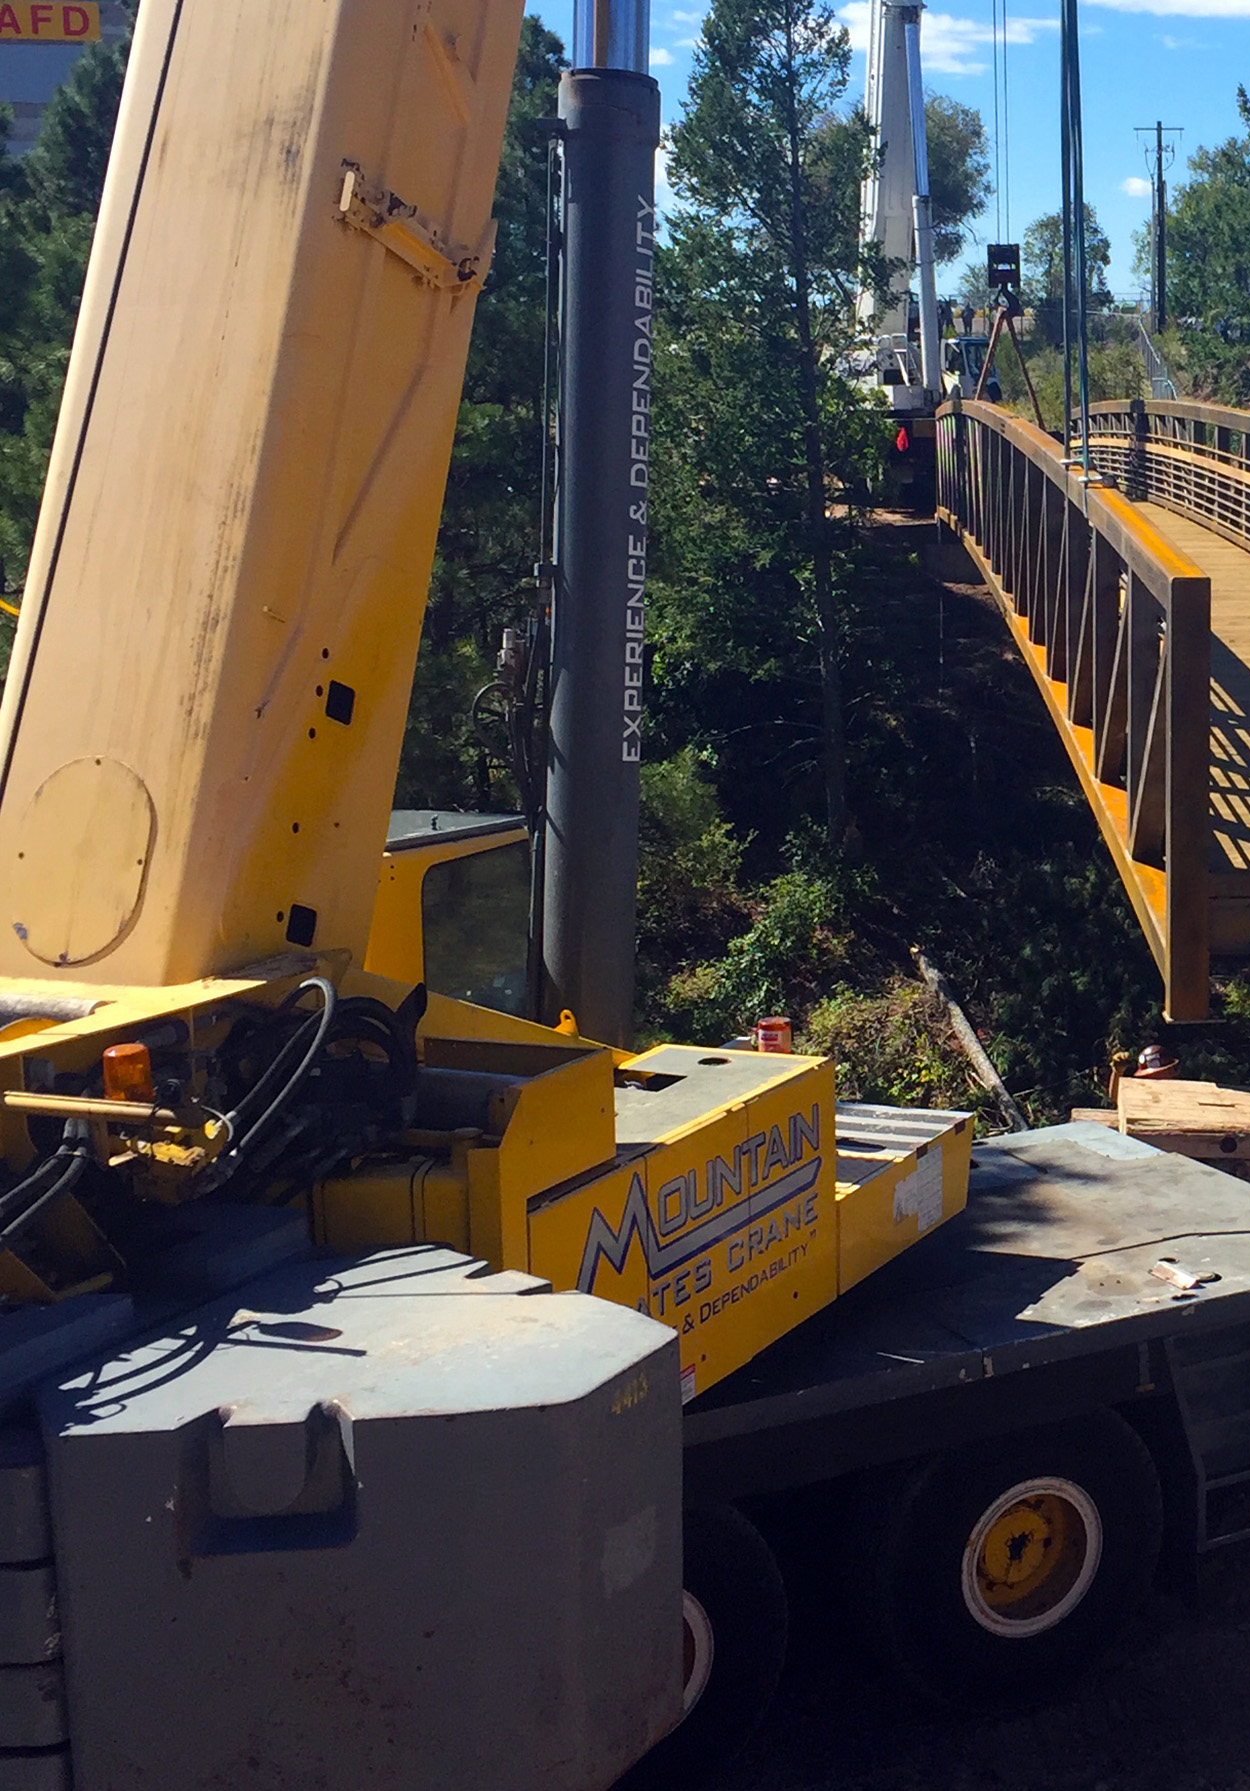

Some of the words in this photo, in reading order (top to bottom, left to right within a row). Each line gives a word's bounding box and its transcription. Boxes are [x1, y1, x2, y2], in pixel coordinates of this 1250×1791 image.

[630, 194, 654, 489] DEPENDABILITY
[630, 500, 648, 526] &
[623, 535, 648, 763] EXPERIENCE
[577, 1103, 820, 1293] MOUNTAIN
[727, 1191, 818, 1272] CRANE
[682, 1313, 695, 1334] &
